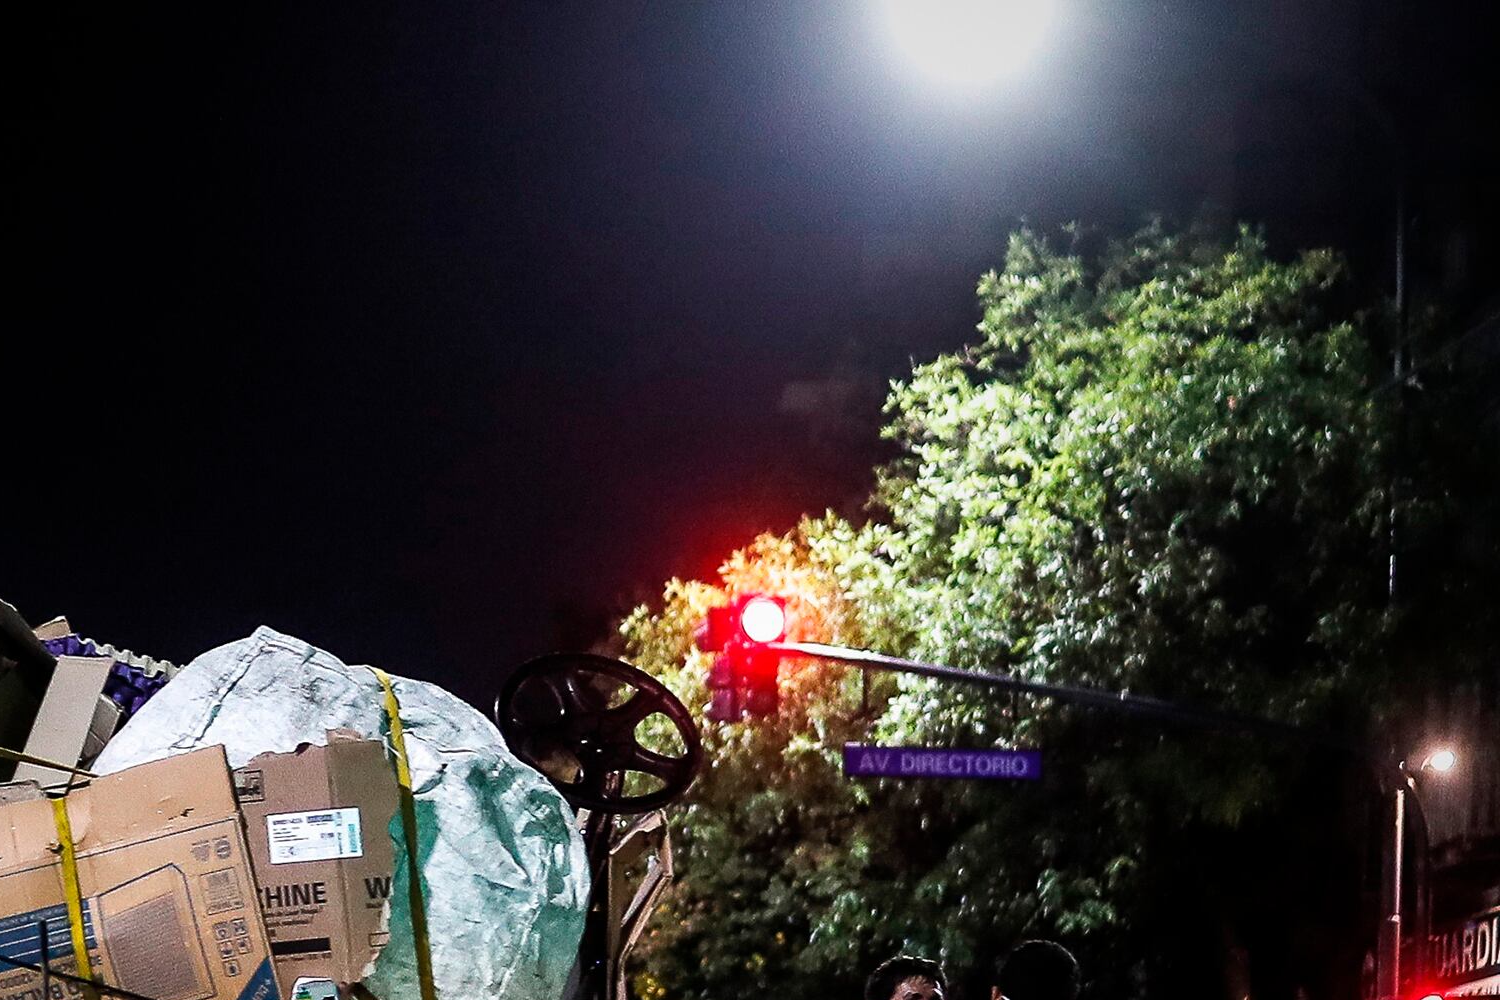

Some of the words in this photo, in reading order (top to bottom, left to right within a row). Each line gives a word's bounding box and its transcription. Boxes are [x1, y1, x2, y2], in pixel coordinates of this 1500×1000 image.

[859, 753, 890, 772] AV
[901, 753, 1028, 777] DIRECTORIO
[259, 882, 327, 909] HINE
